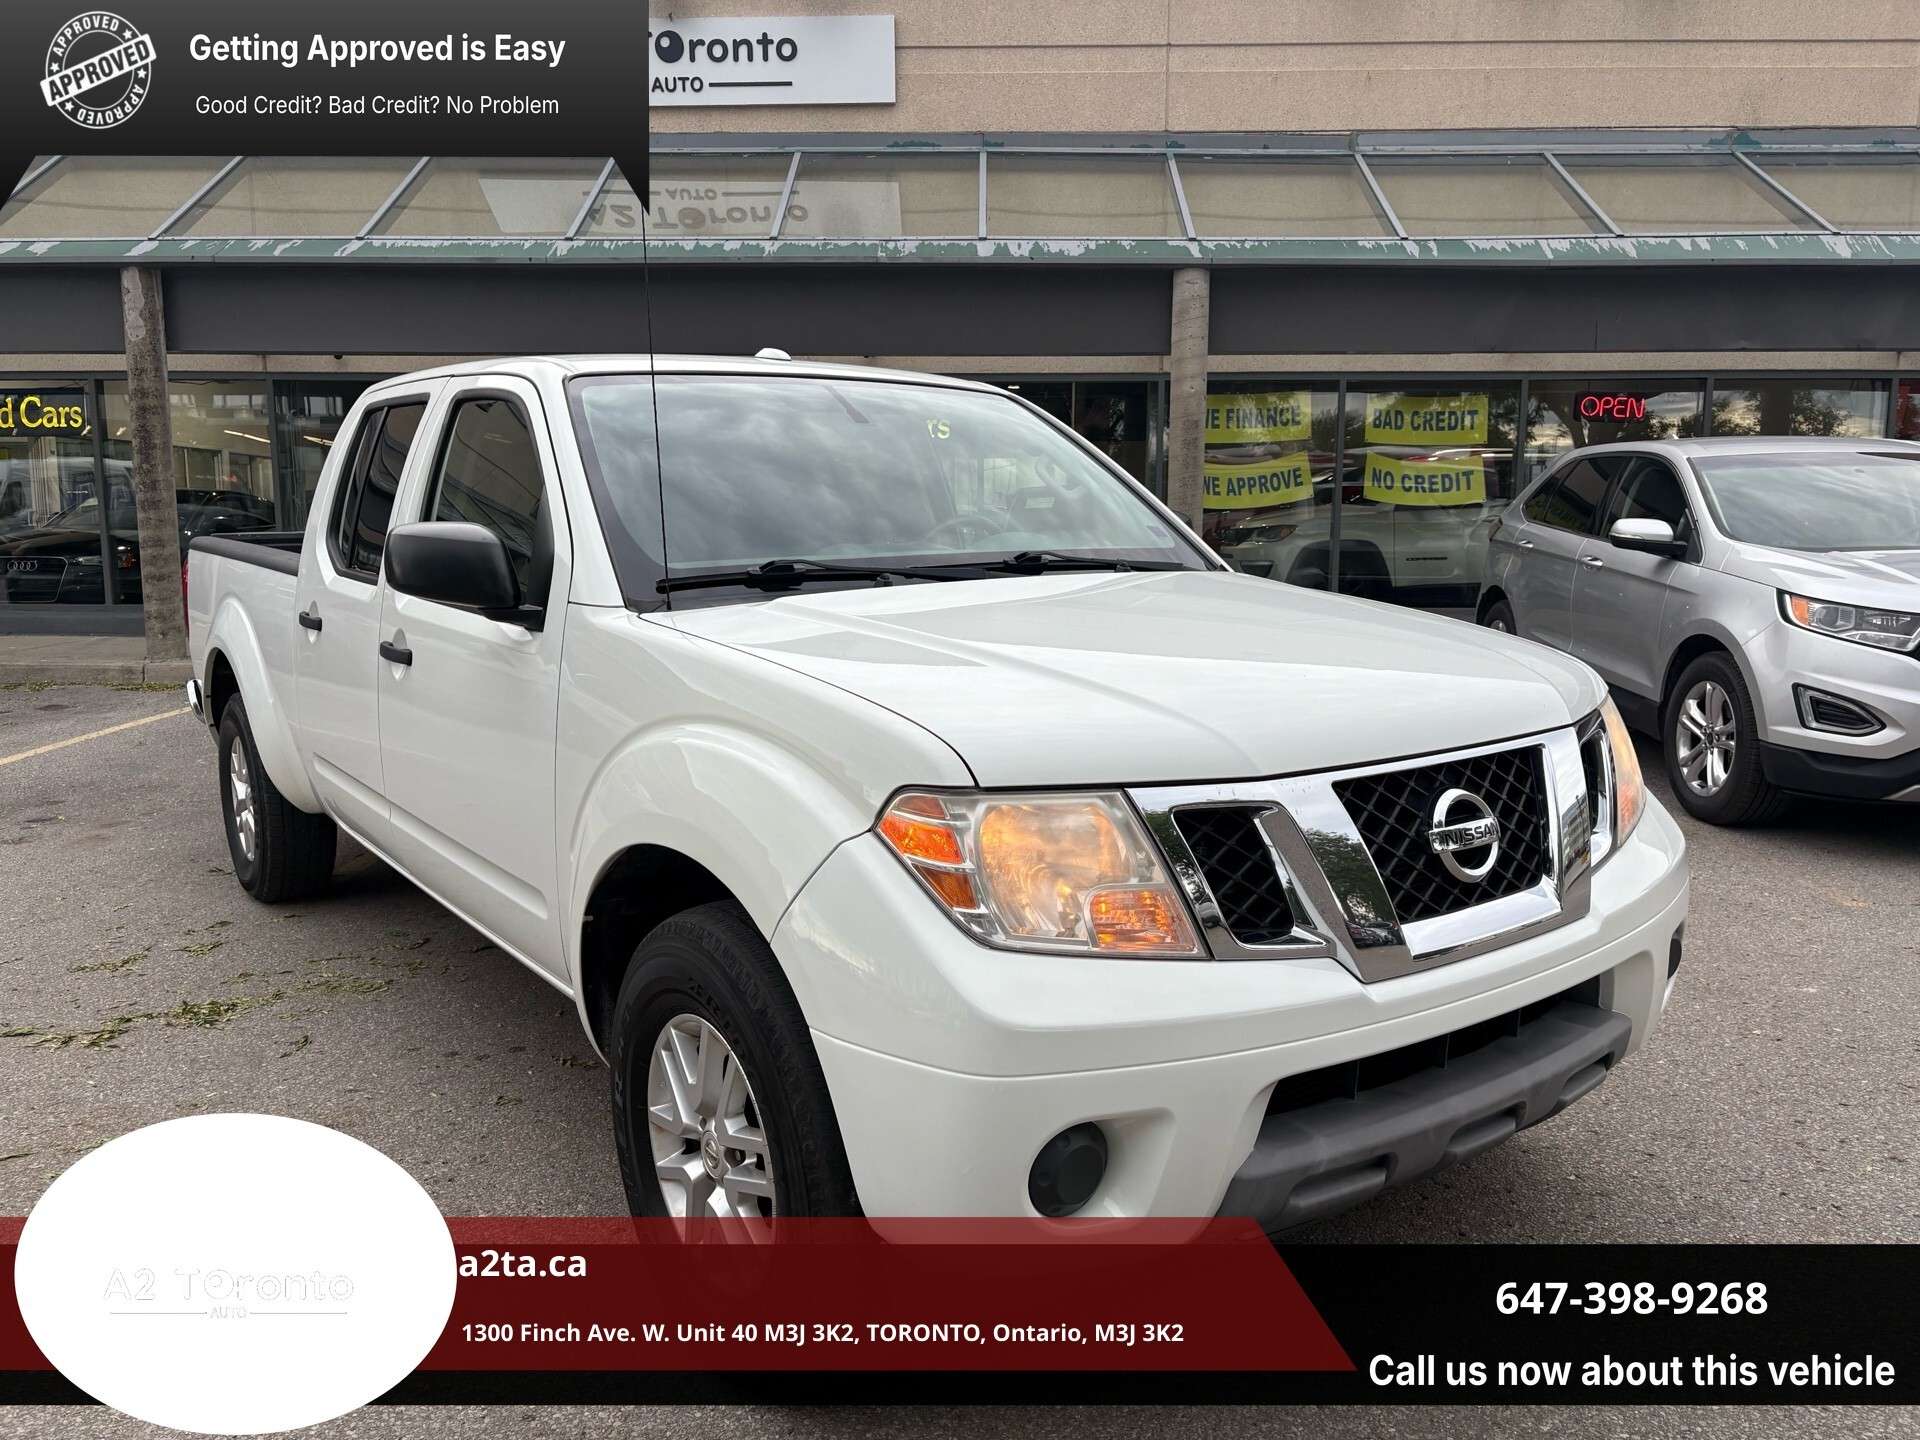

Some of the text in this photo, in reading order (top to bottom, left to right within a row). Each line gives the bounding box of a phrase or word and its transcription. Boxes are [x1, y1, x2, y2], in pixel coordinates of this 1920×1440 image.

[648, 30, 798, 64] Oronto
[651, 76, 704, 93] AUTO
[20, 395, 83, 428] Cars
[1226, 405, 1301, 429] FINANCE
[1373, 408, 1478, 431] BAD CREDIT
[1580, 396, 1645, 418] OPEN
[1226, 465, 1304, 496] APPROVE
[1371, 467, 1474, 493] NO CREDIT
[1444, 821, 1499, 847] NISSAN
